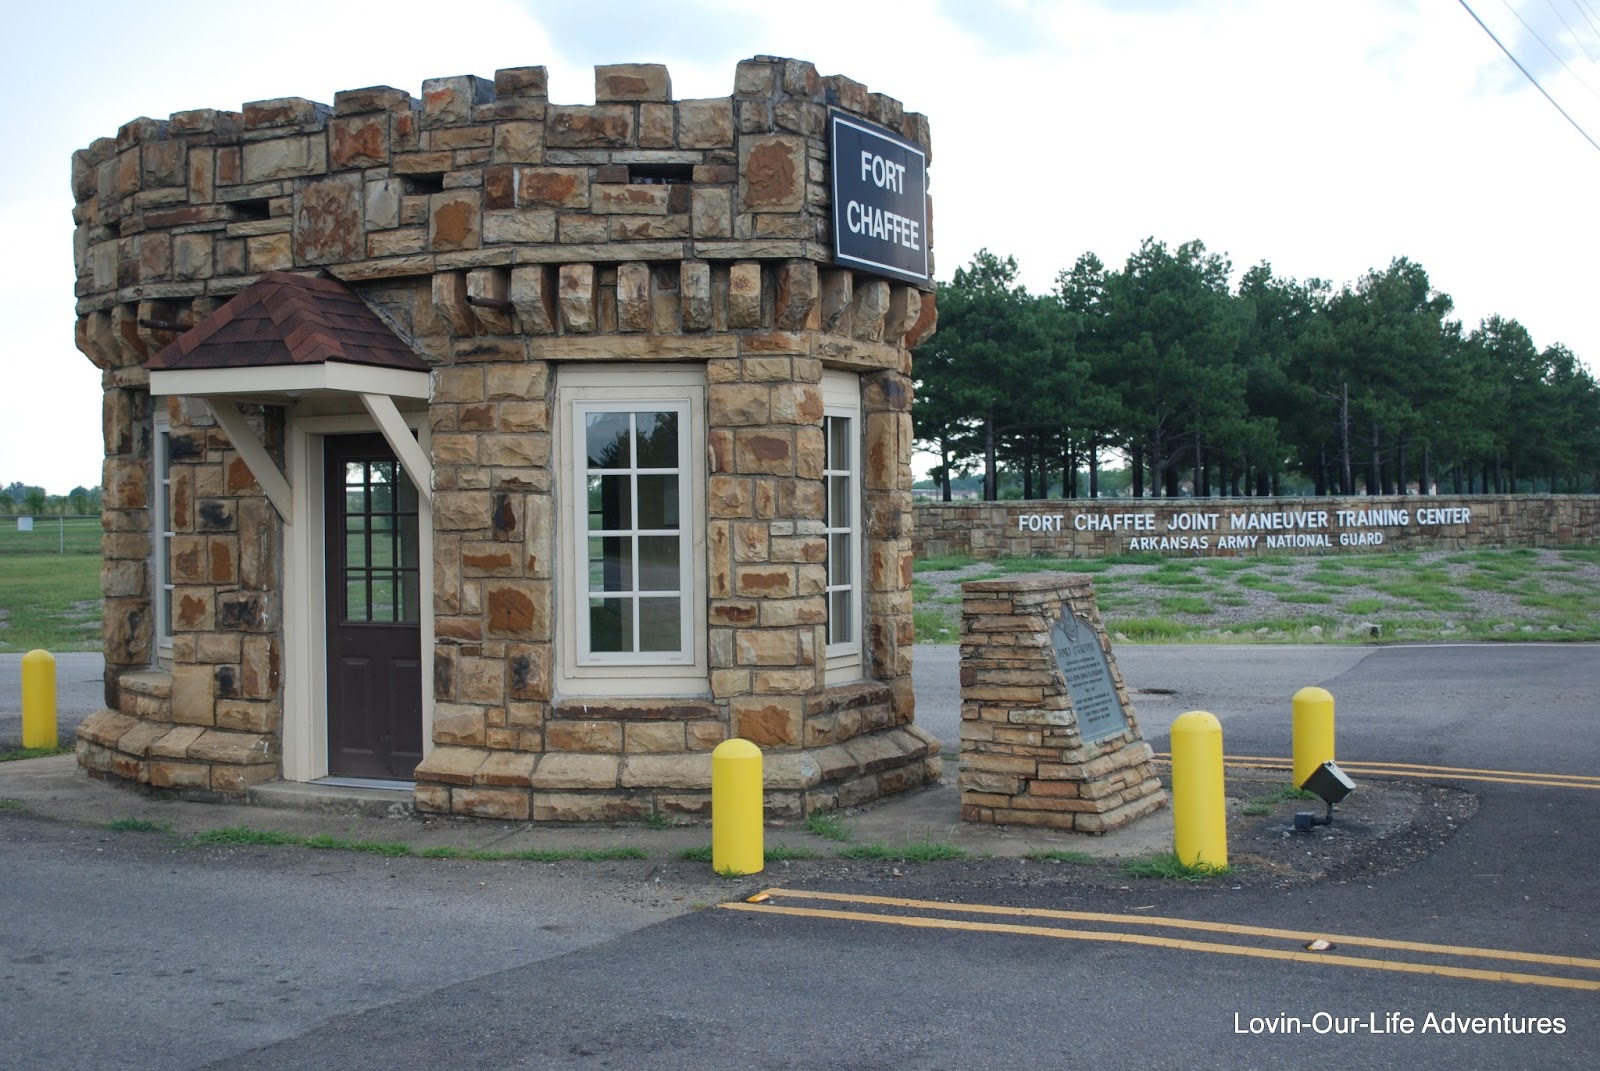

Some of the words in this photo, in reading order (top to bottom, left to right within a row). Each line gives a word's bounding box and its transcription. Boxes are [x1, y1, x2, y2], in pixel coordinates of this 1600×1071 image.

[861, 150, 906, 195] FORT
[847, 200, 920, 251] CHAFFEE
[1018, 514, 1064, 532] FORT
[1074, 513, 1156, 531] CHAFFEE
[1167, 513, 1220, 531] JOINT
[1230, 511, 1328, 530] MANEUVER
[1336, 509, 1409, 527] TRAINING
[1416, 507, 1471, 525] CENTER
[1129, 536, 1209, 550] ARKANSAS
[1217, 535, 1258, 550] ARMY
[1266, 534, 1333, 549] NATIONAL
[1339, 532, 1383, 546] GUARD
